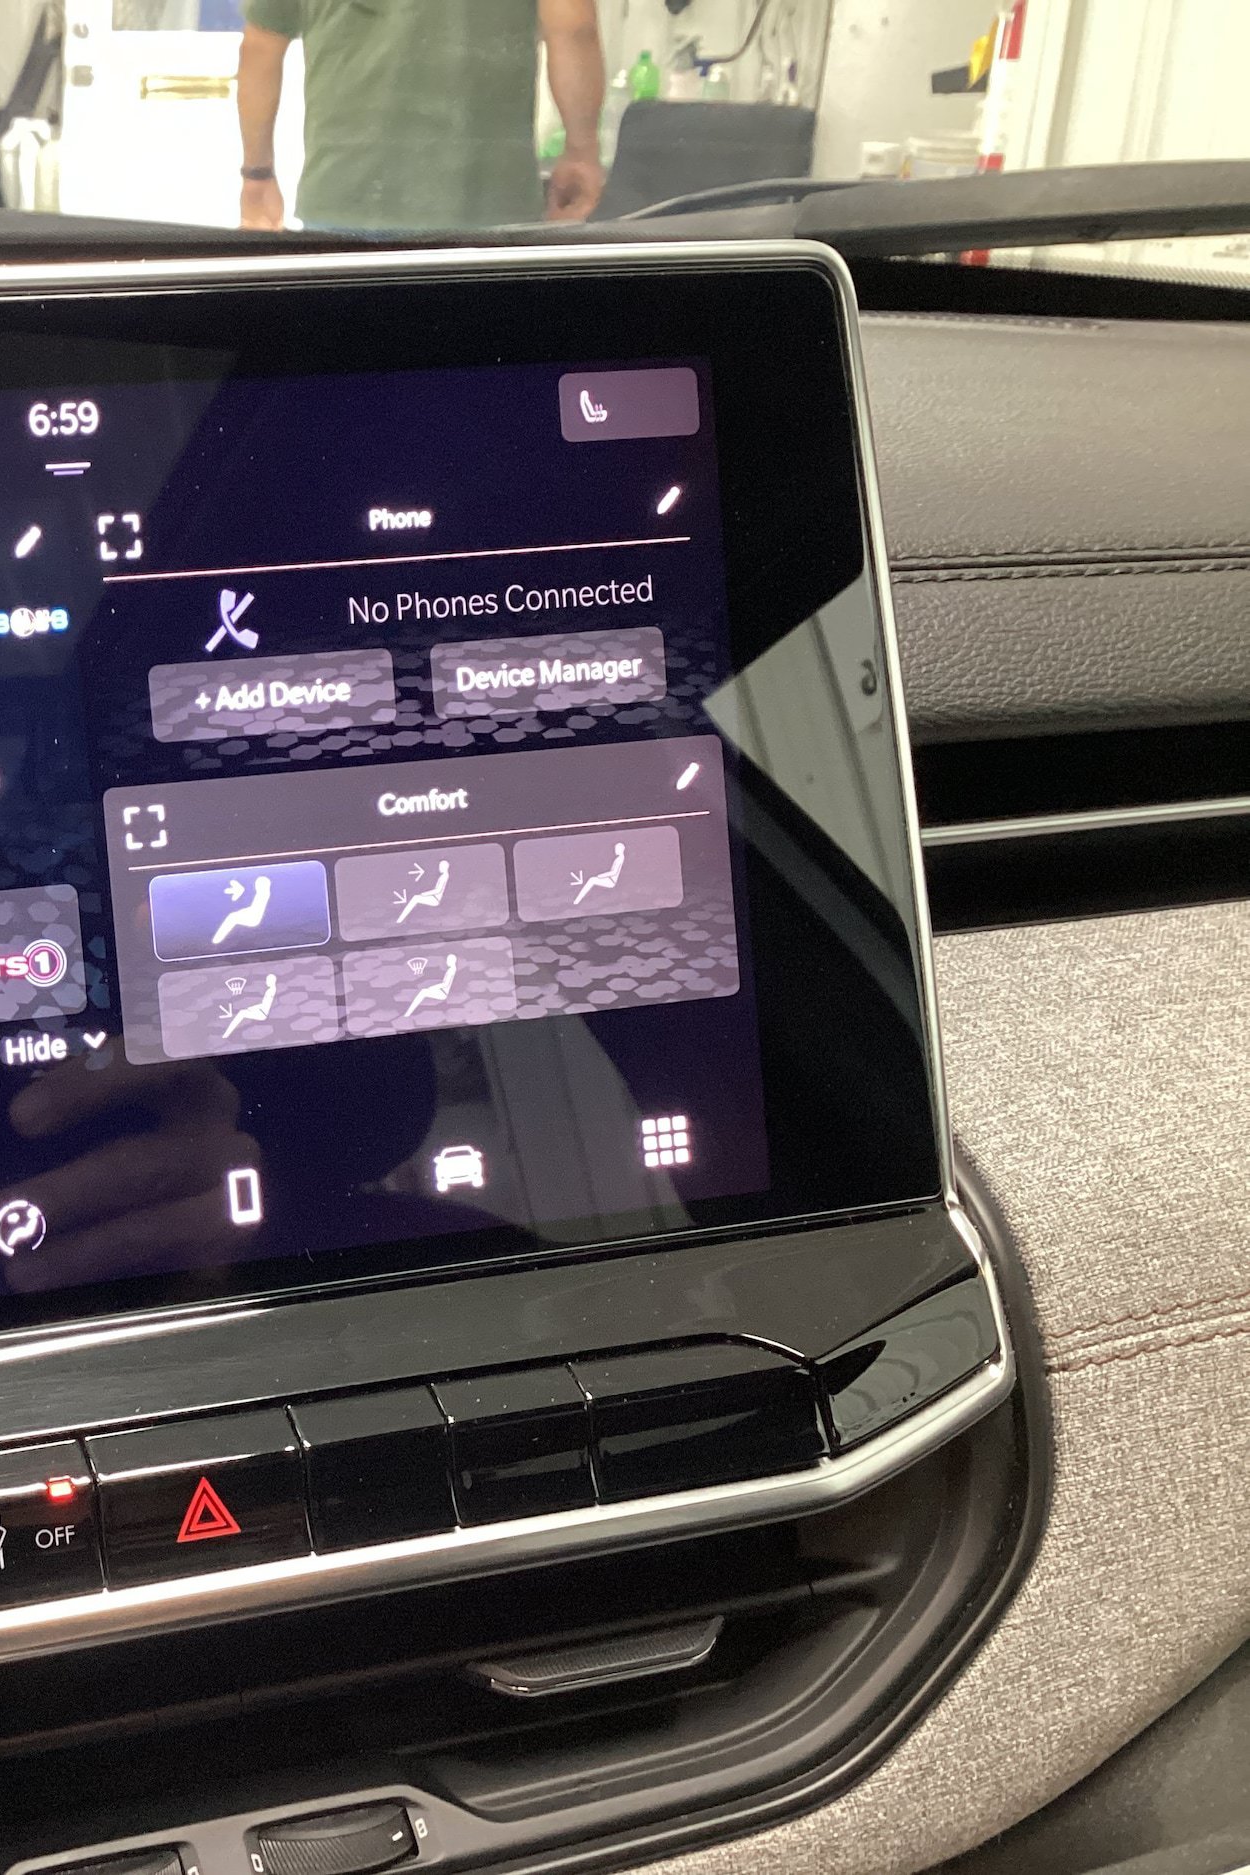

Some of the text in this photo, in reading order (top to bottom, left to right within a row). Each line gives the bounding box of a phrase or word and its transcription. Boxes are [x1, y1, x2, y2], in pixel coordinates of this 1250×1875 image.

[28, 401, 99, 436] 6:59
[369, 508, 432, 531] Phone
[349, 574, 653, 624] No Phones Connected
[456, 658, 643, 692] Device Manager
[215, 682, 265, 712] Add
[269, 678, 351, 708] Device
[378, 788, 468, 816] Comfort
[5, 1033, 67, 1065] Hide
[35, 1524, 75, 1549] OFF
